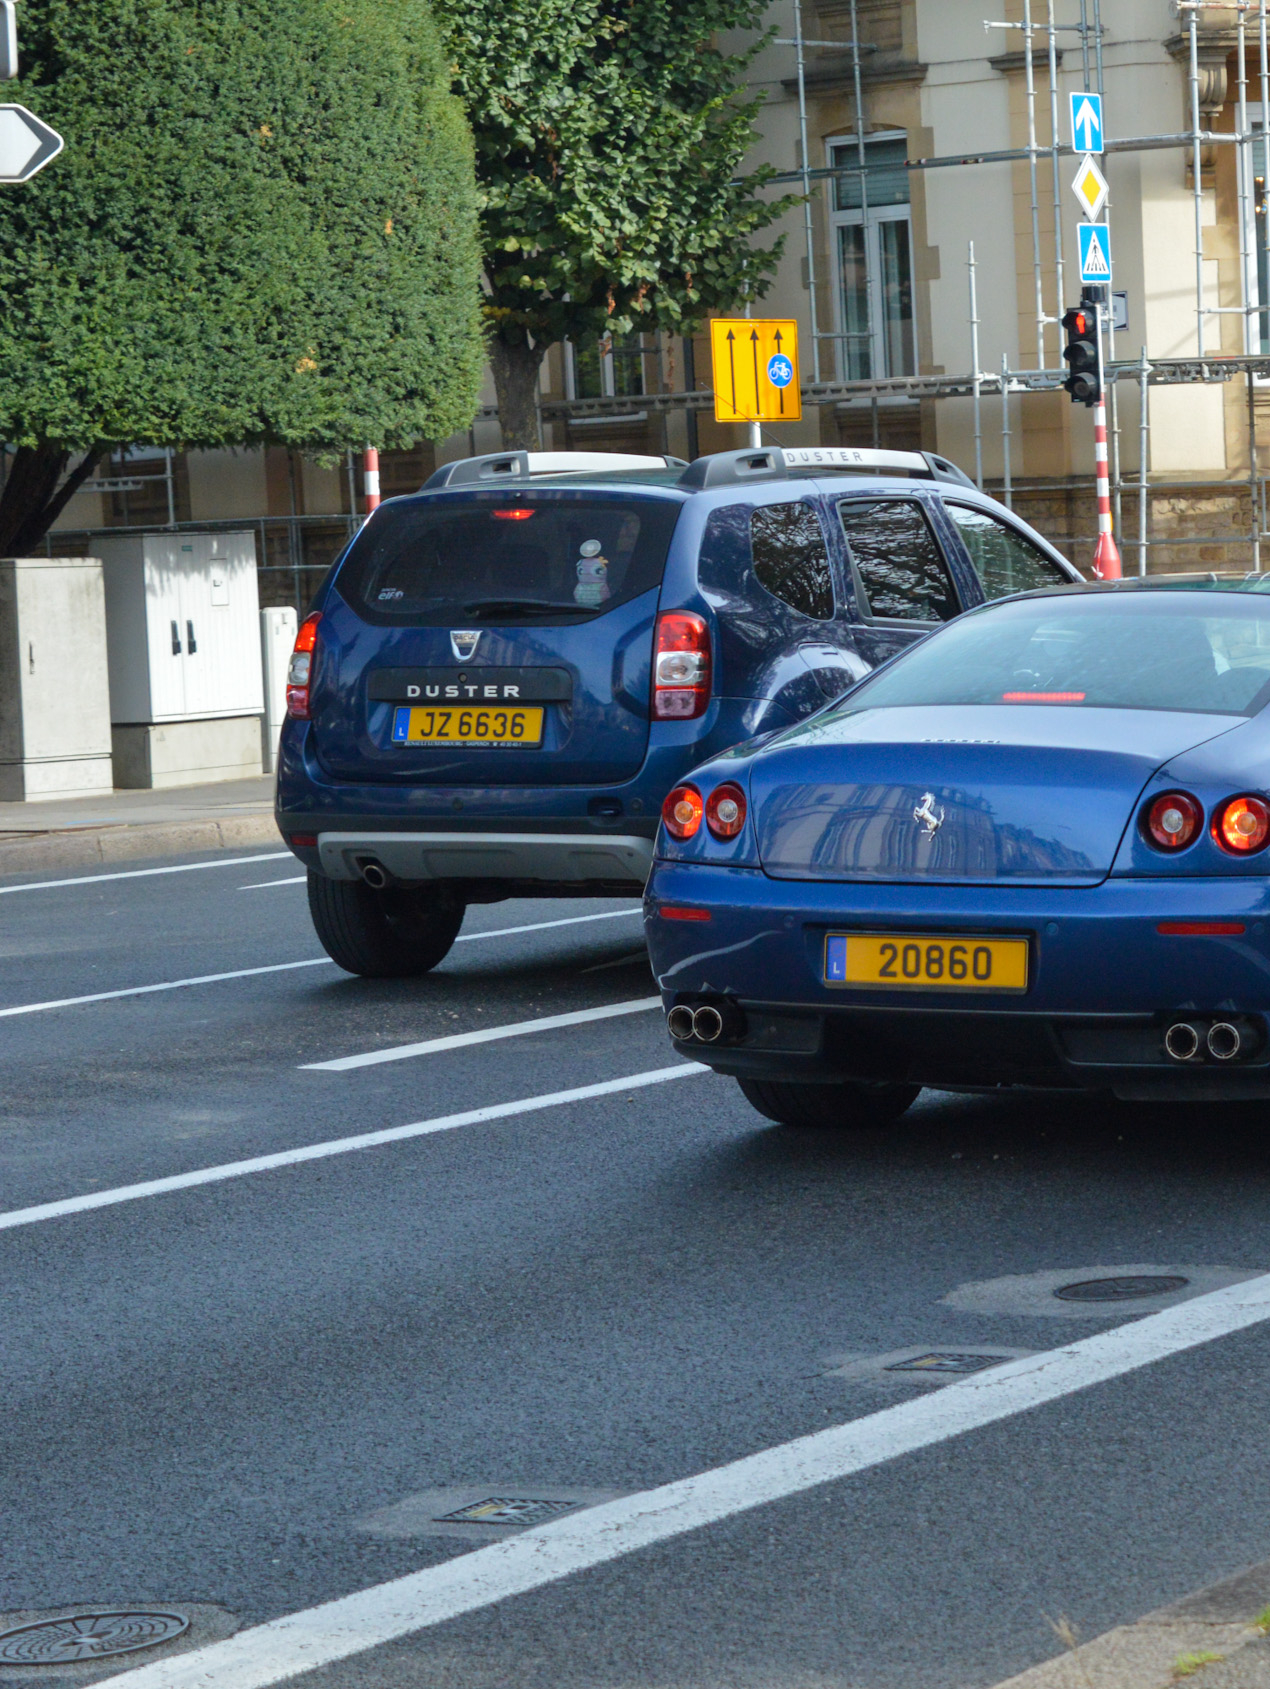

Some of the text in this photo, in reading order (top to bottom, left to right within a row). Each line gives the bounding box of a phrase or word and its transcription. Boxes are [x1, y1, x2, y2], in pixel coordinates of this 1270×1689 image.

[786, 452, 863, 462] DUSTER
[407, 685, 520, 698] DUSTER
[420, 711, 526, 738] JZ 6636
[398, 727, 404, 736] L
[833, 962, 840, 974] L
[878, 943, 993, 981] 20860
